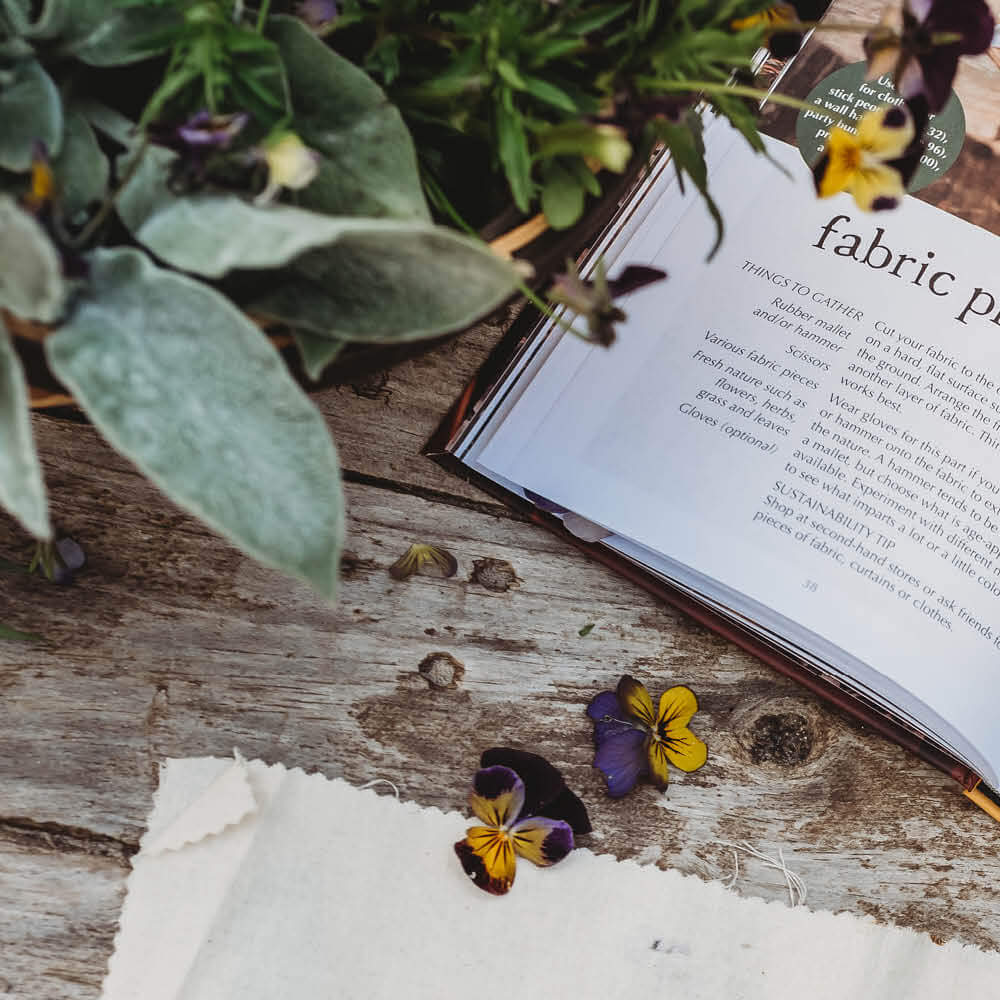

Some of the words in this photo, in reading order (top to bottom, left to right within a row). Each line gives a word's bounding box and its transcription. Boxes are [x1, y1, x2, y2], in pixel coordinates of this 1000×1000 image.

[804, 109, 835, 127] party
[828, 88, 855, 103] stick
[927, 127, 948, 144] 32),
[859, 83, 876, 96] for
[824, 101, 848, 115] wall
[928, 142, 947, 158] 96),
[812, 214, 956, 296] fabric
[742, 260, 792, 287] THINGS
[791, 282, 810, 296] TO
[812, 292, 864, 322] GATHER
[771, 297, 814, 322] Rubber
[814, 319, 852, 340] mallet
[705, 330, 746, 356] Various
[746, 350, 781, 372] fabric
[779, 368, 820, 390] pieces
[752, 308, 794, 329] and/or
[793, 324, 844, 352] hammer
[785, 345, 831, 371] Scissors
[874, 321, 895, 337] Cut
[898, 333, 925, 351] your
[926, 346, 959, 370] fabric
[961, 365, 973, 377] to
[975, 373, 994, 389] the
[692, 350, 724, 370] Fresh
[724, 366, 763, 387] nature
[763, 385, 792, 401] such
[793, 398, 808, 408] as
[714, 377, 758, 406] flowers,
[761, 398, 796, 424] herbs,
[841, 376, 875, 398] works
[876, 391, 902, 414] best.
[848, 363, 894, 389] another
[895, 383, 924, 404] layer
[925, 403, 941, 413] of
[940, 408, 974, 436] fabric.
[857, 348, 876, 363] the
[875, 360, 922, 389] ground.
[920, 383, 970, 412] Arrange
[972, 408, 991, 425] the
[865, 336, 881, 348] on
[893, 346, 923, 370] hard,
[926, 364, 946, 381] flat
[946, 377, 988, 404] surface
[679, 403, 719, 426] Gloves
[720, 422, 778, 454] (optional)
[695, 389, 728, 407] grass
[728, 404, 756, 418] and
[753, 412, 790, 436] leaves
[830, 392, 861, 415] Wear
[860, 412, 898, 435] gloves
[901, 431, 919, 445] for
[920, 441, 941, 458] this
[940, 455, 966, 472] part
[968, 467, 979, 479] if
[980, 476, 1000, 495] you
[802, 437, 810, 445] a
[812, 441, 850, 466] mallet,
[854, 459, 875, 478] but
[877, 474, 918, 500] choose
[921, 498, 949, 520] what
[951, 515, 961, 527] is
[810, 421, 830, 437] the
[832, 433, 871, 459] nature.
[874, 454, 884, 464] A
[887, 458, 936, 491] hammer
[937, 488, 968, 512] tends
[970, 508, 982, 521] to
[983, 516, 998, 533] be
[819, 409, 834, 419] or
[835, 413, 884, 445] hammer
[885, 443, 912, 460] onto
[914, 456, 934, 472] the
[935, 467, 968, 493] fabric
[970, 489, 982, 502] to
[772, 480, 874, 538] SUSTAINABILITY
[876, 534, 896, 550] TIP
[784, 462, 797, 474] to
[798, 471, 820, 486] see
[822, 482, 851, 503] what
[853, 496, 896, 527] imparts
[898, 524, 906, 533] a
[908, 527, 925, 544] lot
[926, 542, 940, 552] or
[941, 551, 949, 560] a
[951, 554, 976, 578] little
[793, 450, 847, 483] available.
[851, 477, 917, 520] Experiment
[920, 516, 944, 536] with
[946, 534, 992, 569] different
[752, 511, 793, 535] pieces
[794, 531, 812, 542] of
[809, 536, 844, 564] fabric,
[849, 561, 895, 592] curtains
[898, 590, 911, 600] or
[912, 599, 953, 632] clothes.
[763, 495, 794, 517] Shop
[796, 513, 809, 524] at
[810, 521, 888, 567] second-hand
[887, 563, 920, 588] stores
[922, 586, 936, 596] or
[937, 596, 956, 612] ask
[958, 608, 993, 640] friends
